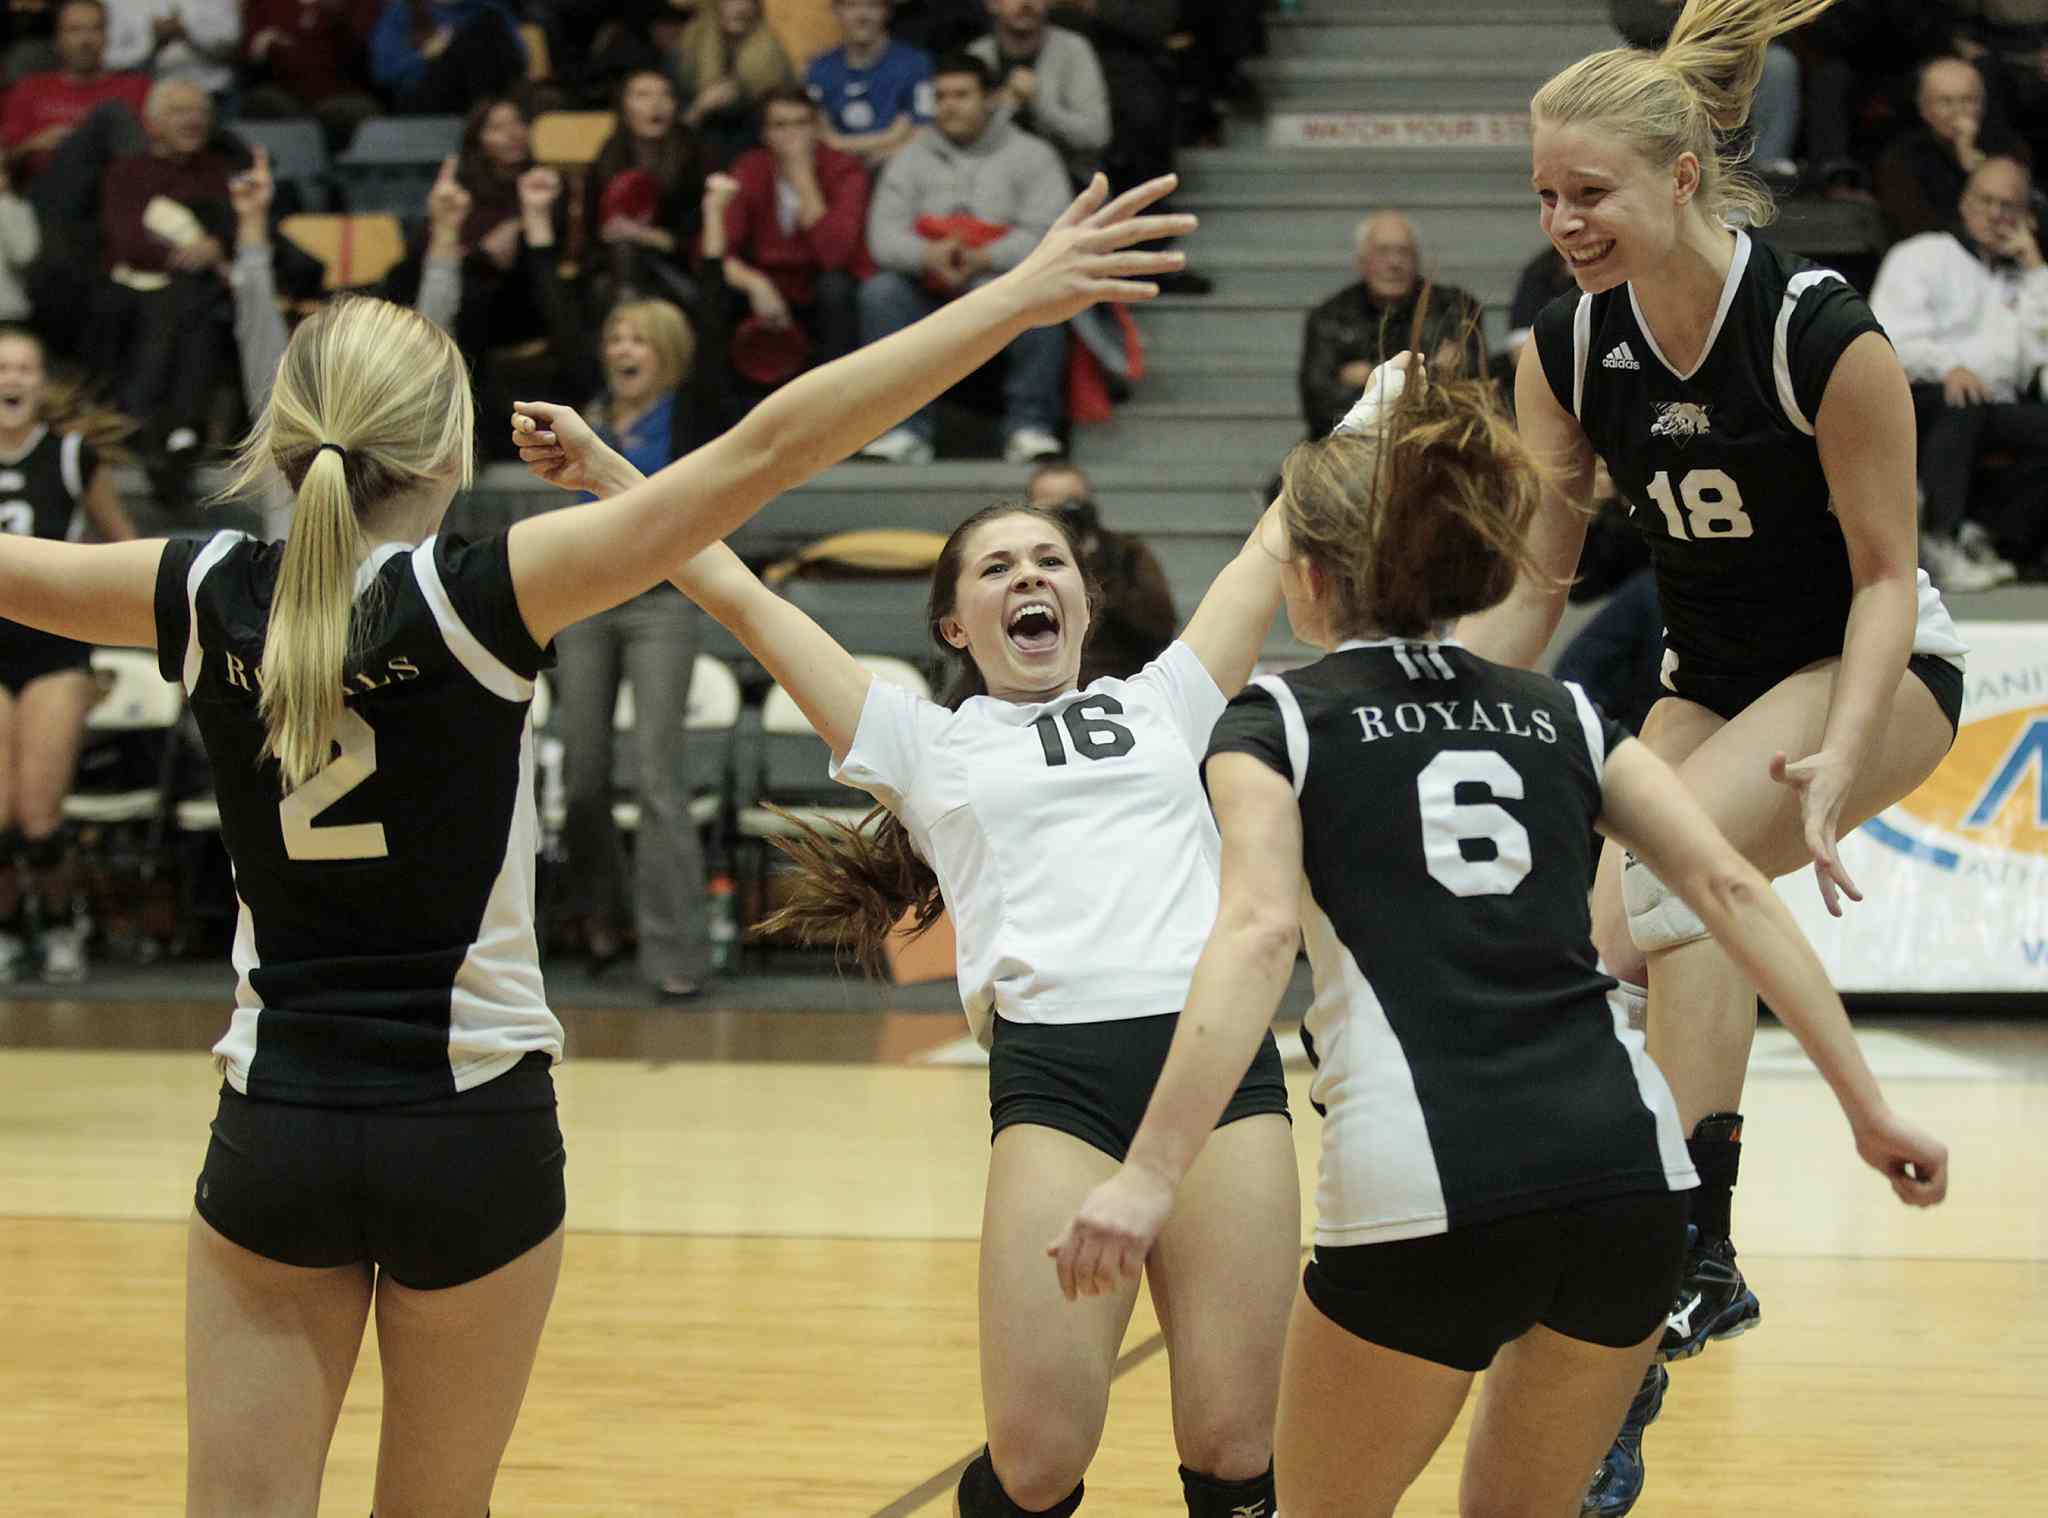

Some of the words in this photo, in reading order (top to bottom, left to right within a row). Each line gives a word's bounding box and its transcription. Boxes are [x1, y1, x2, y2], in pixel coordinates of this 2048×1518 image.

[1602, 358, 1640, 370] adidas
[1646, 469, 1753, 541] 18
[1026, 693, 1136, 767] 16
[1351, 700, 1557, 744] ROYALS
[270, 703, 389, 861] 2
[1417, 750, 1532, 897] 6
